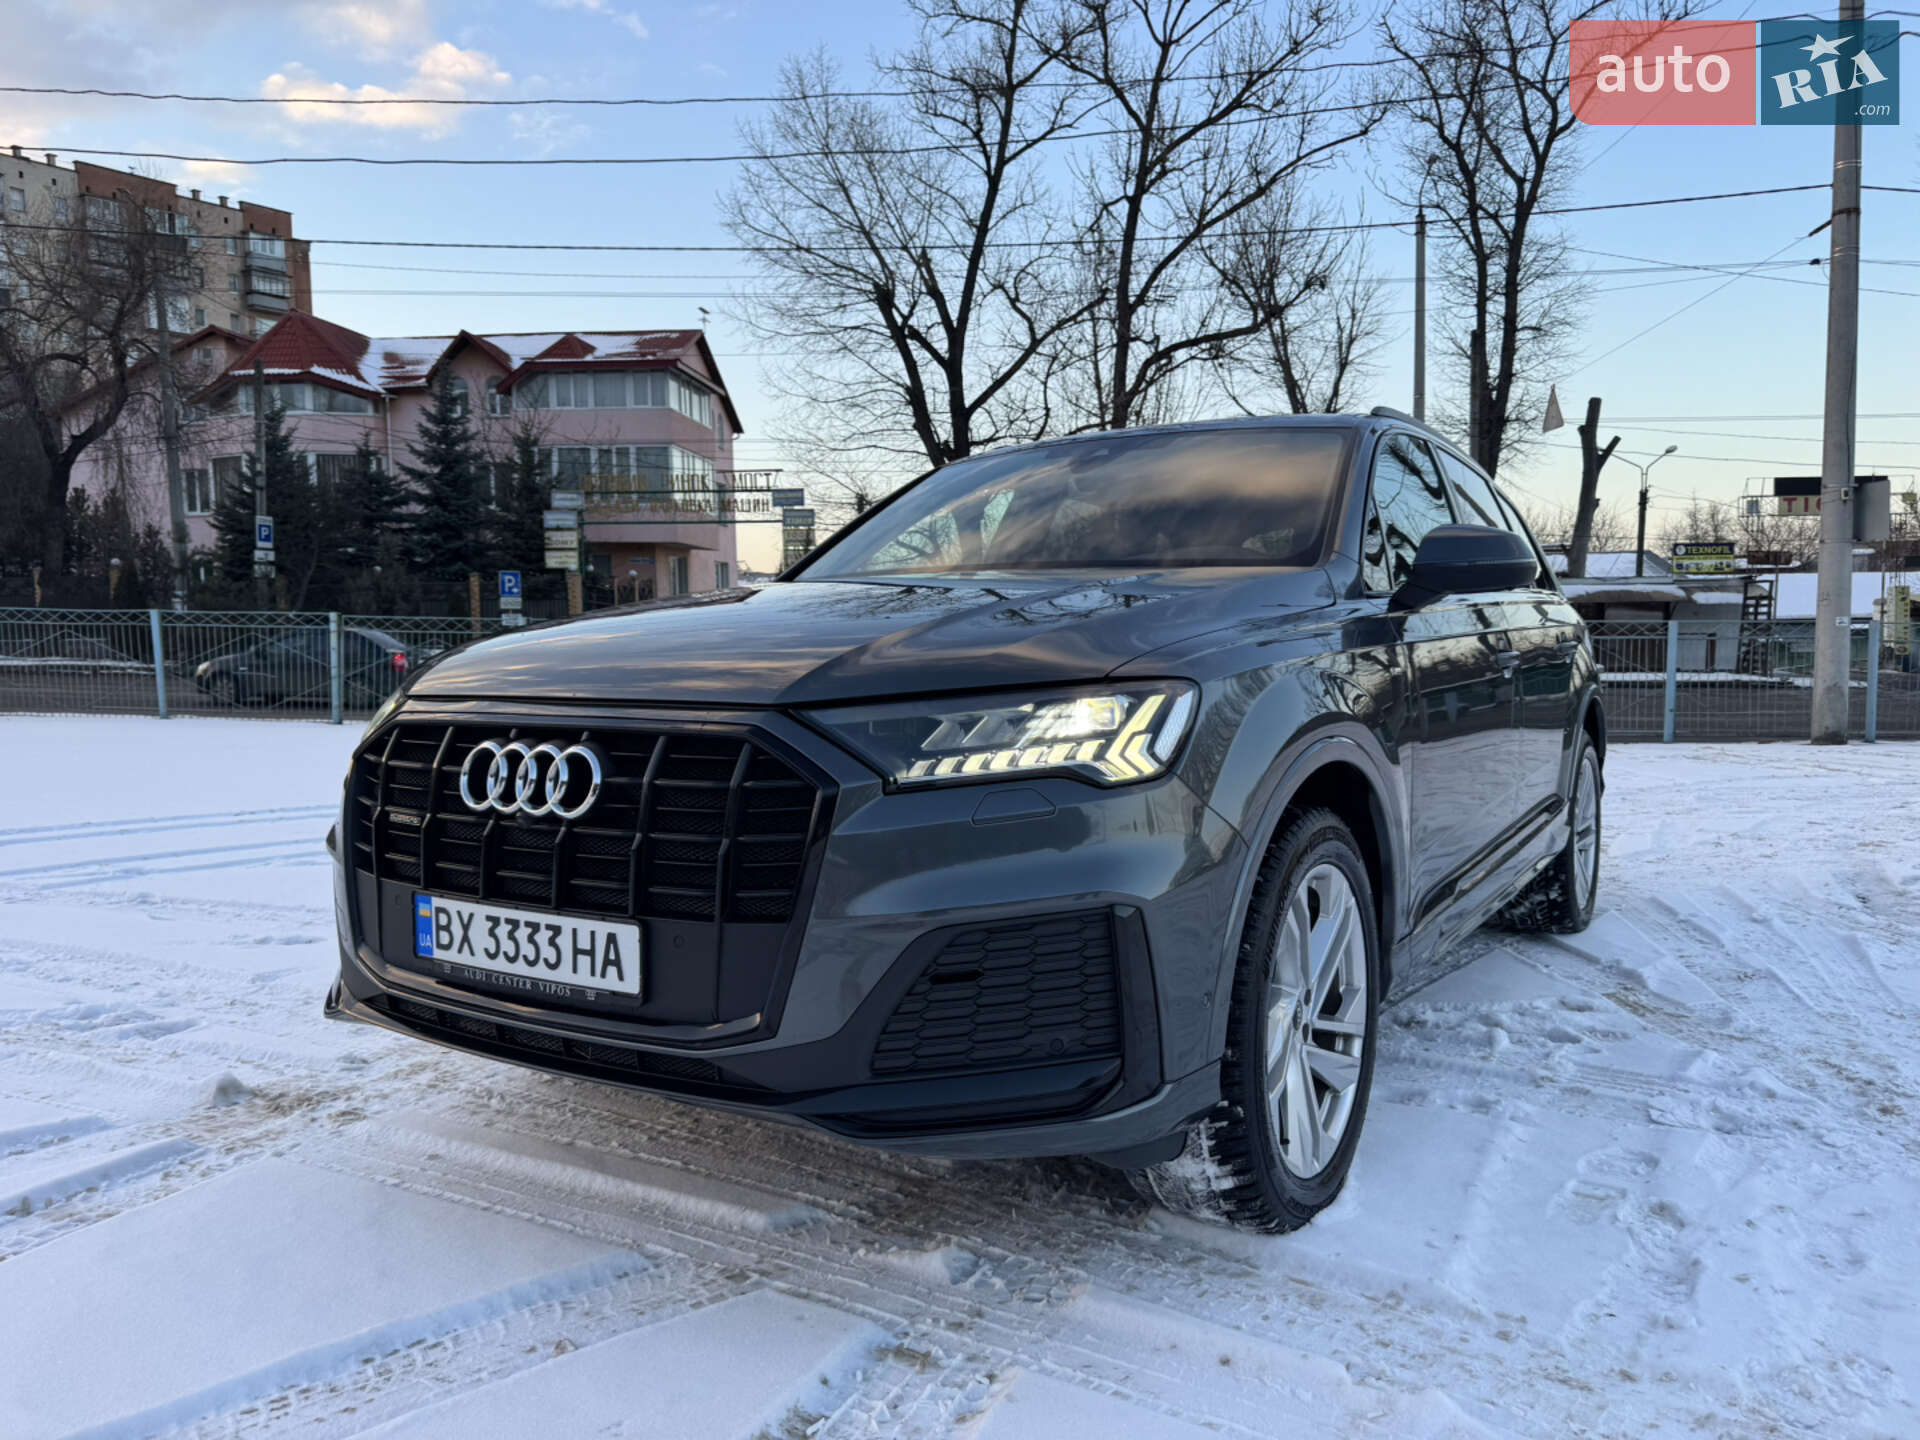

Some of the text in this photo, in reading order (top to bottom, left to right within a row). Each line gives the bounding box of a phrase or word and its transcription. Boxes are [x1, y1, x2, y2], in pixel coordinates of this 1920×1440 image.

[260, 527, 270, 539] P
[504, 575, 516, 593] P
[419, 934, 433, 948] UA
[434, 906, 625, 982] BX 3333 HA
[463, 968, 489, 982] AUDI
[492, 971, 533, 991] CENTER
